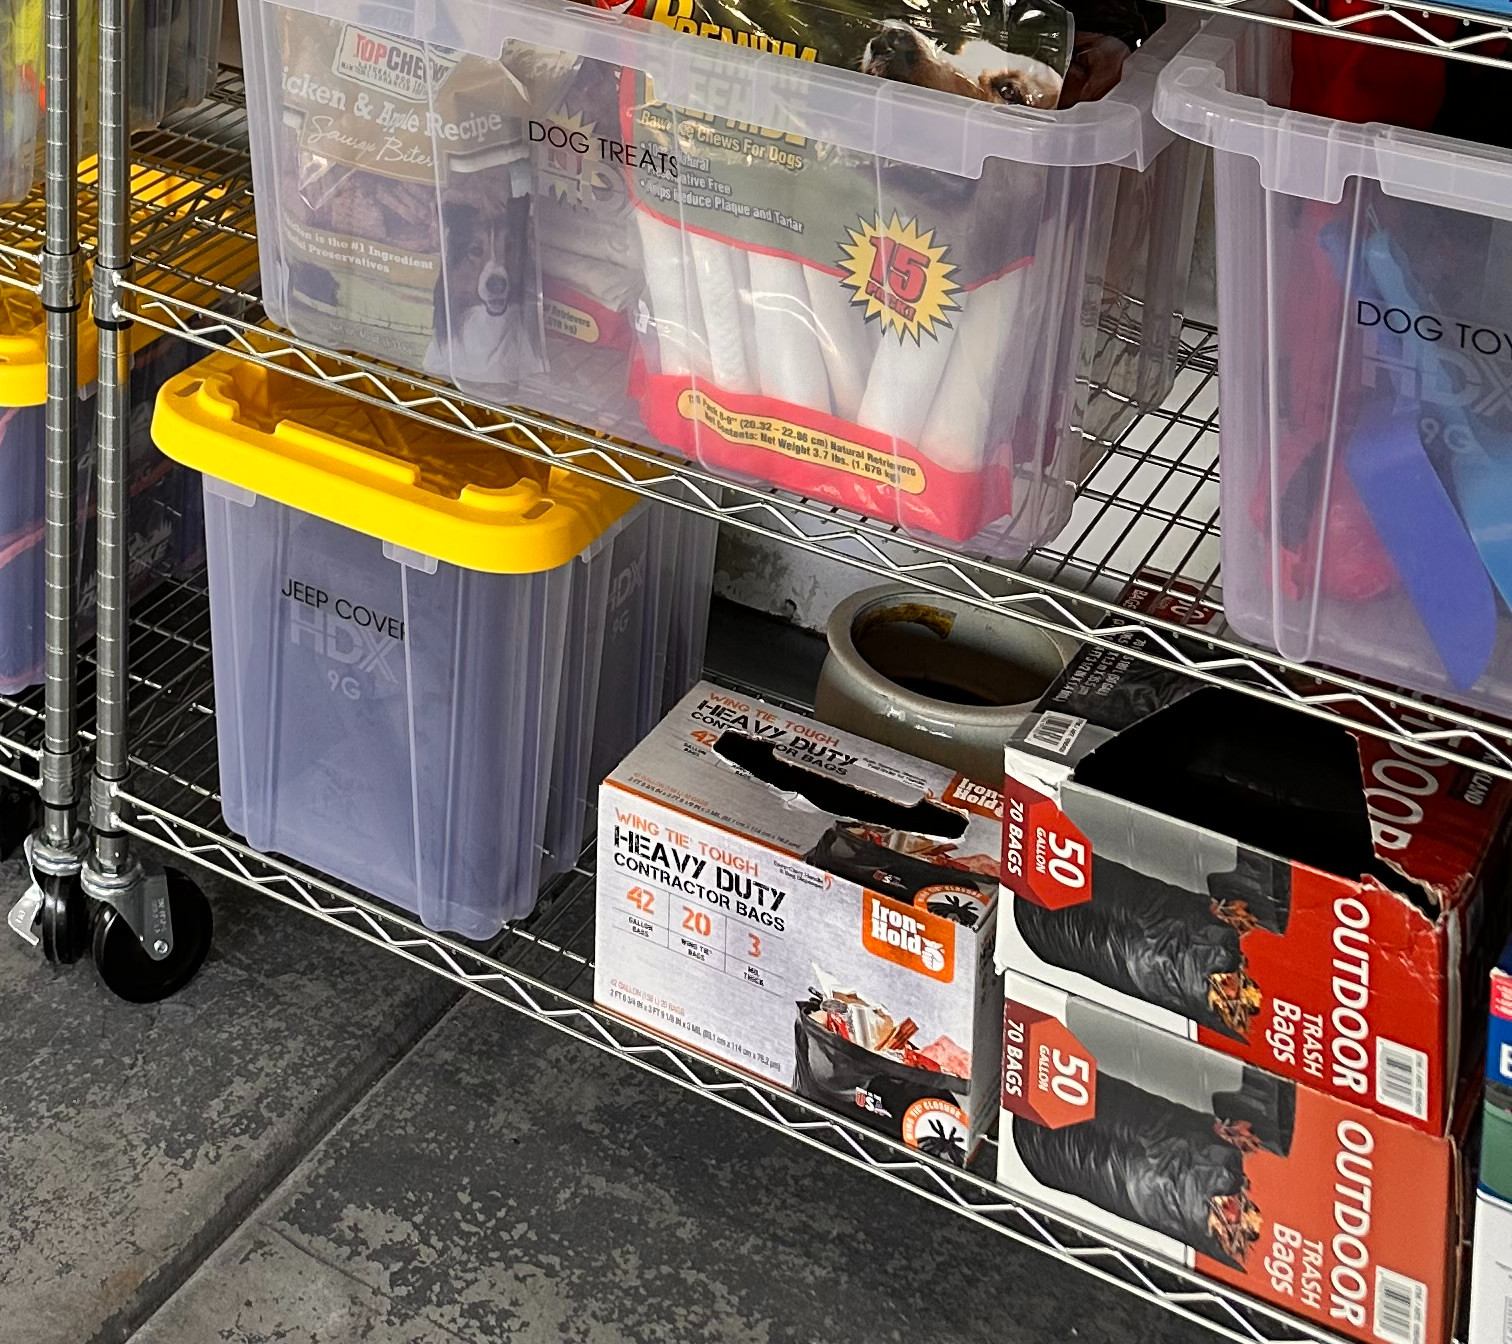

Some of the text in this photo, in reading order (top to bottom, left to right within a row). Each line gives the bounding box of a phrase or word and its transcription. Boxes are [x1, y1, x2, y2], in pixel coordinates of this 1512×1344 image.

[354, 33, 388, 64] TOP
[354, 93, 502, 141] & Recipe
[376, 136, 434, 167] Bites
[529, 120, 679, 179] DOG TREATS
[743, 136, 766, 158] For
[769, 146, 803, 172] Dogs
[708, 179, 732, 194] Free
[714, 196, 804, 233] Plaque and Tartar
[869, 235, 929, 301] 15
[1356, 299, 1444, 344] DOG
[778, 438, 829, 460] Weight 3.7
[831, 442, 865, 459] Natural
[1419, 415, 1477, 455] 9G
[280, 578, 328, 608] JEEP
[288, 612, 399, 686] HDX
[326, 668, 362, 701] 9G
[689, 730, 719, 747] 42
[696, 700, 859, 766] HEAVY DUTY
[710, 692, 841, 747] WING TIE TOUGH
[801, 752, 848, 776] BAGS
[953, 787, 998, 810] Hold
[958, 777, 1005, 801] Iron-
[615, 807, 759, 877] WING TIE TOUGH
[1007, 797, 1024, 877] 70 BAGS
[1036, 827, 1047, 874] GALLON
[1048, 831, 1085, 888] 50
[614, 825, 786, 912] HEAVY DUTY
[614, 853, 785, 932] CONTRACTOR BAGS
[626, 885, 761, 958] 42 20 3
[628, 917, 653, 932] GALLON
[871, 919, 922, 956] Hold
[872, 898, 926, 934] Iron-
[632, 926, 705, 962] BAGS BAGS
[1332, 897, 1371, 1096] OUTDOOR
[1273, 997, 1301, 1066] Bags
[1303, 1013, 1324, 1078] TRASH
[1006, 1021, 1024, 1098] 70 BAGS
[1038, 1045, 1050, 1093] GALLON
[1051, 1049, 1090, 1107] 50
[1329, 1119, 1375, 1327] OUTDOOR
[1271, 1222, 1302, 1296] Bags
[1302, 1239, 1324, 1310] TRASH
